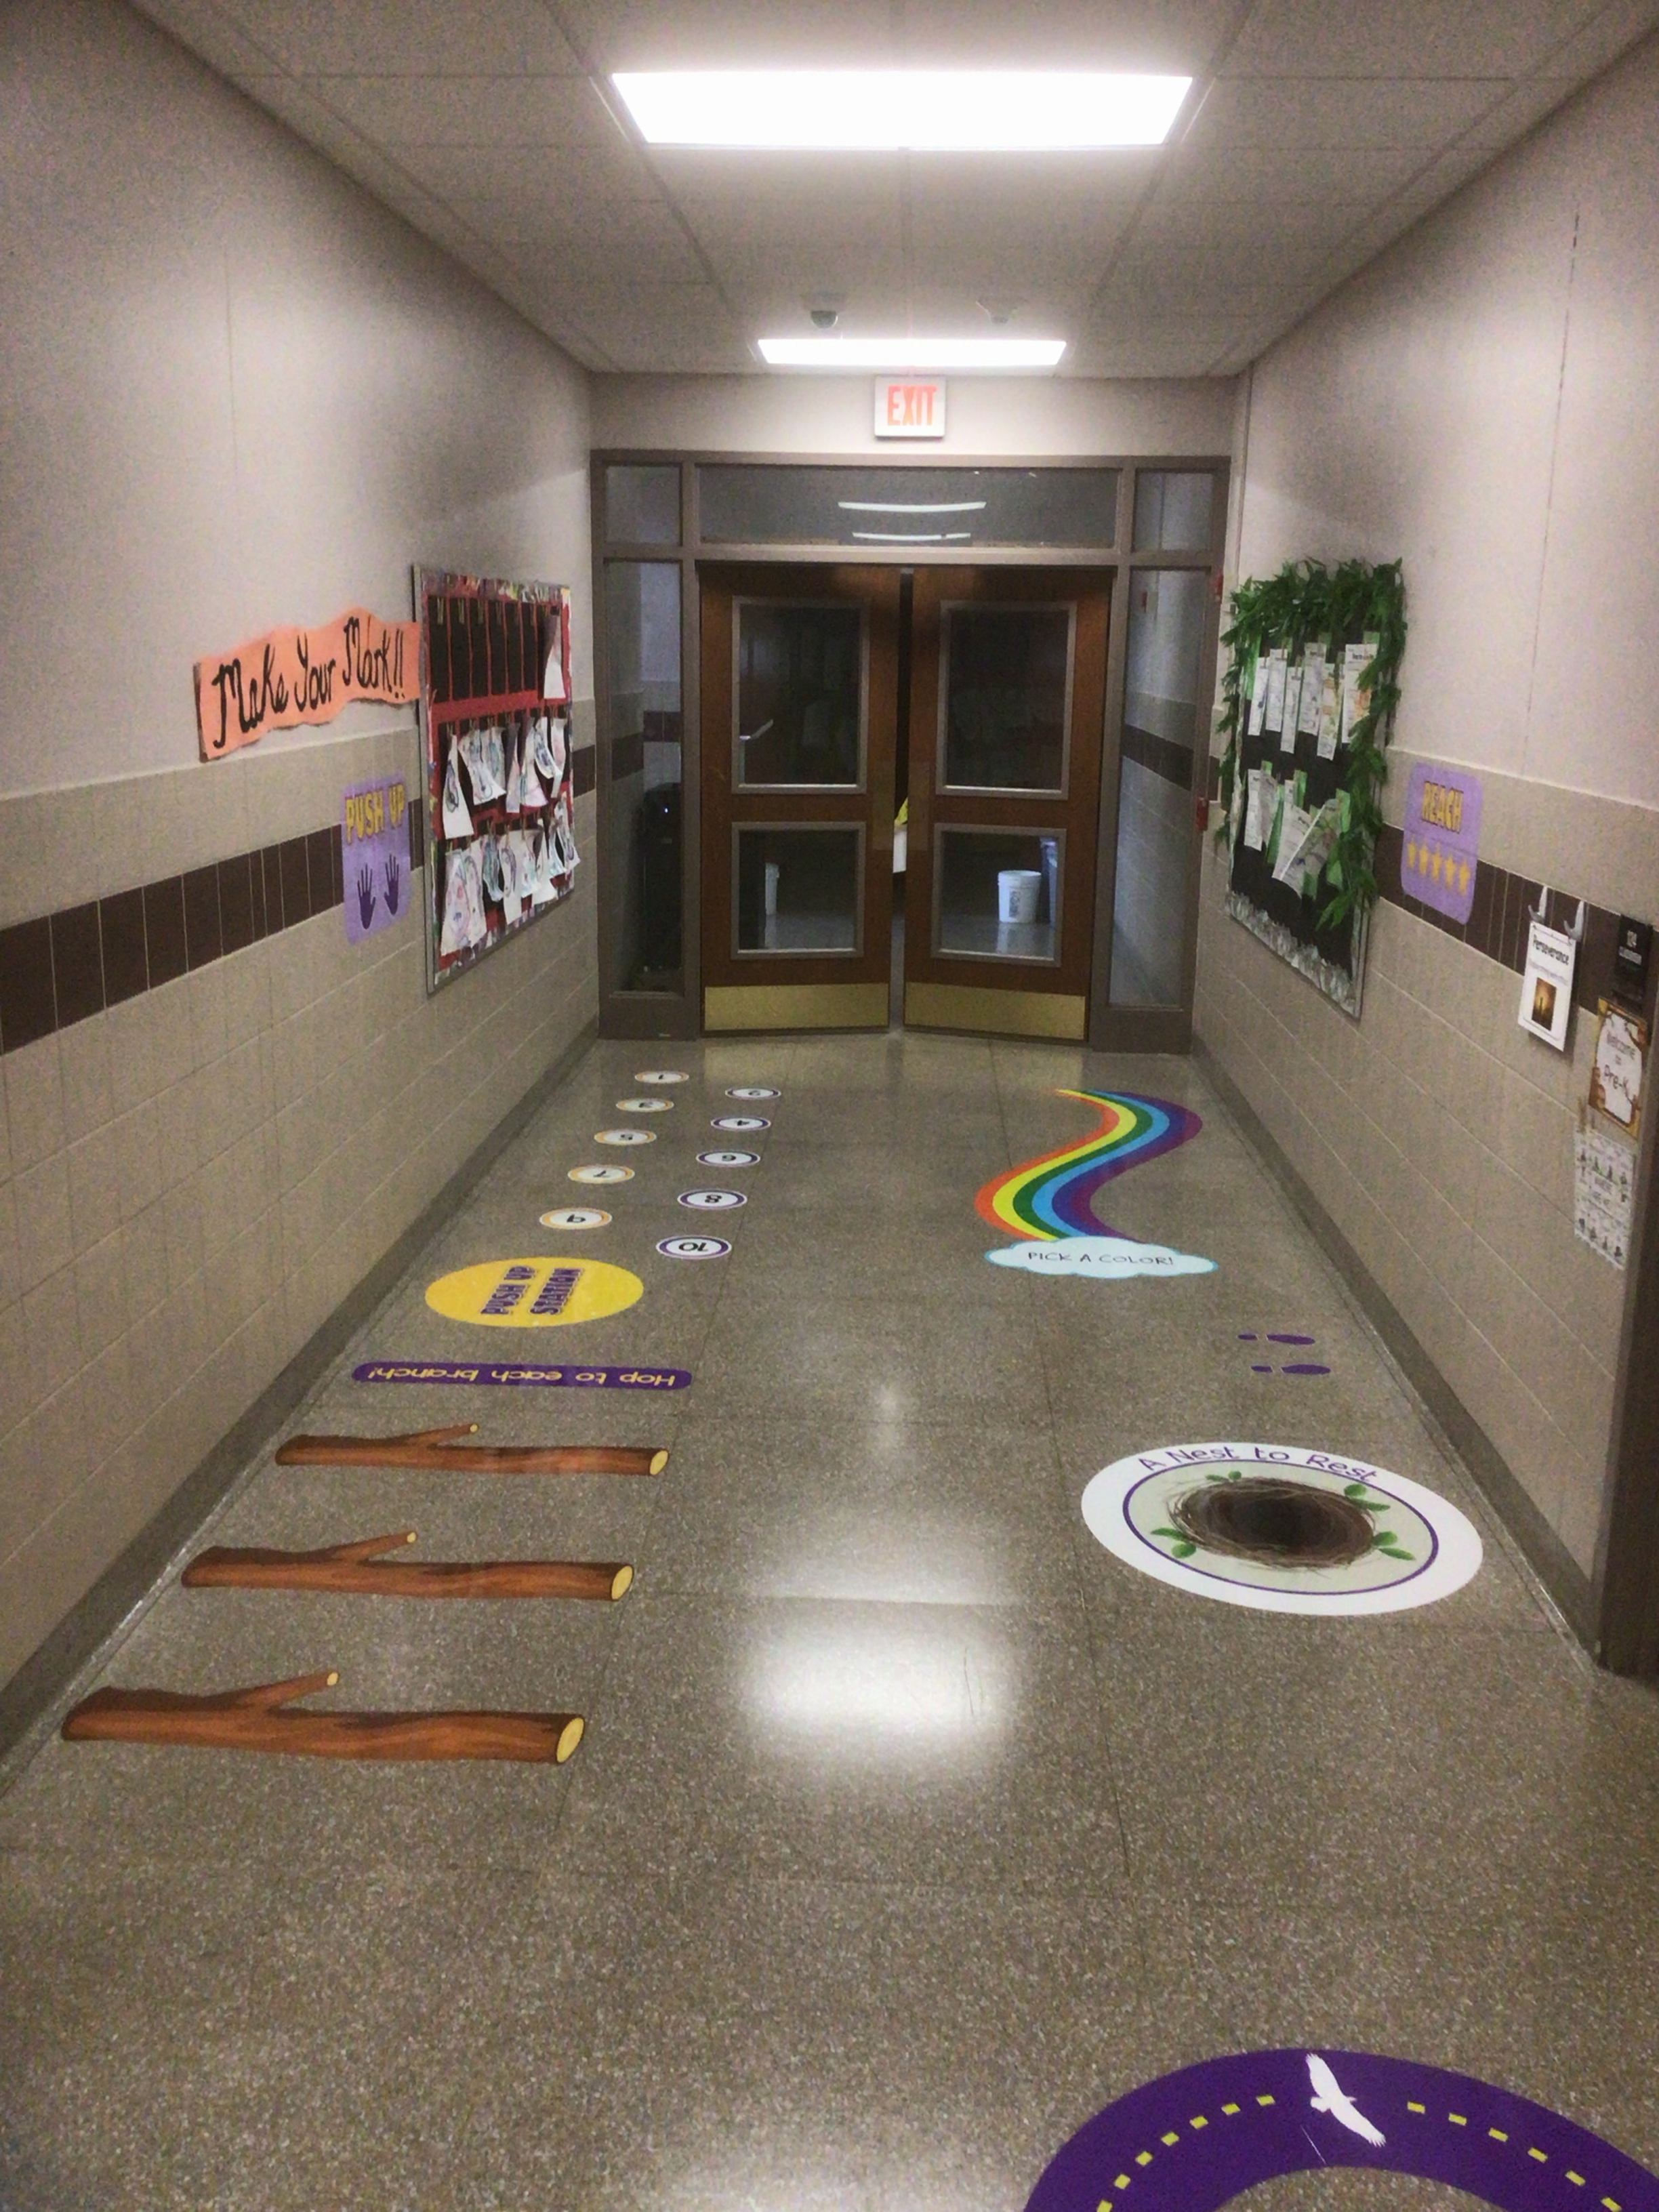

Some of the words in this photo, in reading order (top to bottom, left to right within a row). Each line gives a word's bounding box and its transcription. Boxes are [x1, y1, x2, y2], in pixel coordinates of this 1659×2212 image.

[887, 385, 938, 426] EXIT
[211, 643, 289, 749] Make
[294, 632, 336, 712] Your
[345, 787, 385, 845] PUSH
[389, 783, 405, 828] UP
[1421, 781, 1464, 834] REACH
[704, 1194, 722, 1204] 8
[678, 1242, 709, 1252] 10
[1027, 1252, 1072, 1262] PICK
[1079, 1253, 1092, 1263] A
[1099, 1254, 1174, 1266] COLOR!
[480, 1283, 528, 1315] PUSH
[504, 1265, 537, 1281] UP
[529, 1267, 583, 1315] STATION
[367, 1367, 479, 1382] branch!
[491, 1370, 562, 1382] each
[575, 1372, 607, 1385] to
[619, 1371, 676, 1387] Hop
[1139, 1457, 1166, 1471] A
[1165, 1446, 1240, 1464] Nest
[1254, 1446, 1290, 1460] to
[1305, 1453, 1378, 1482] Rest
